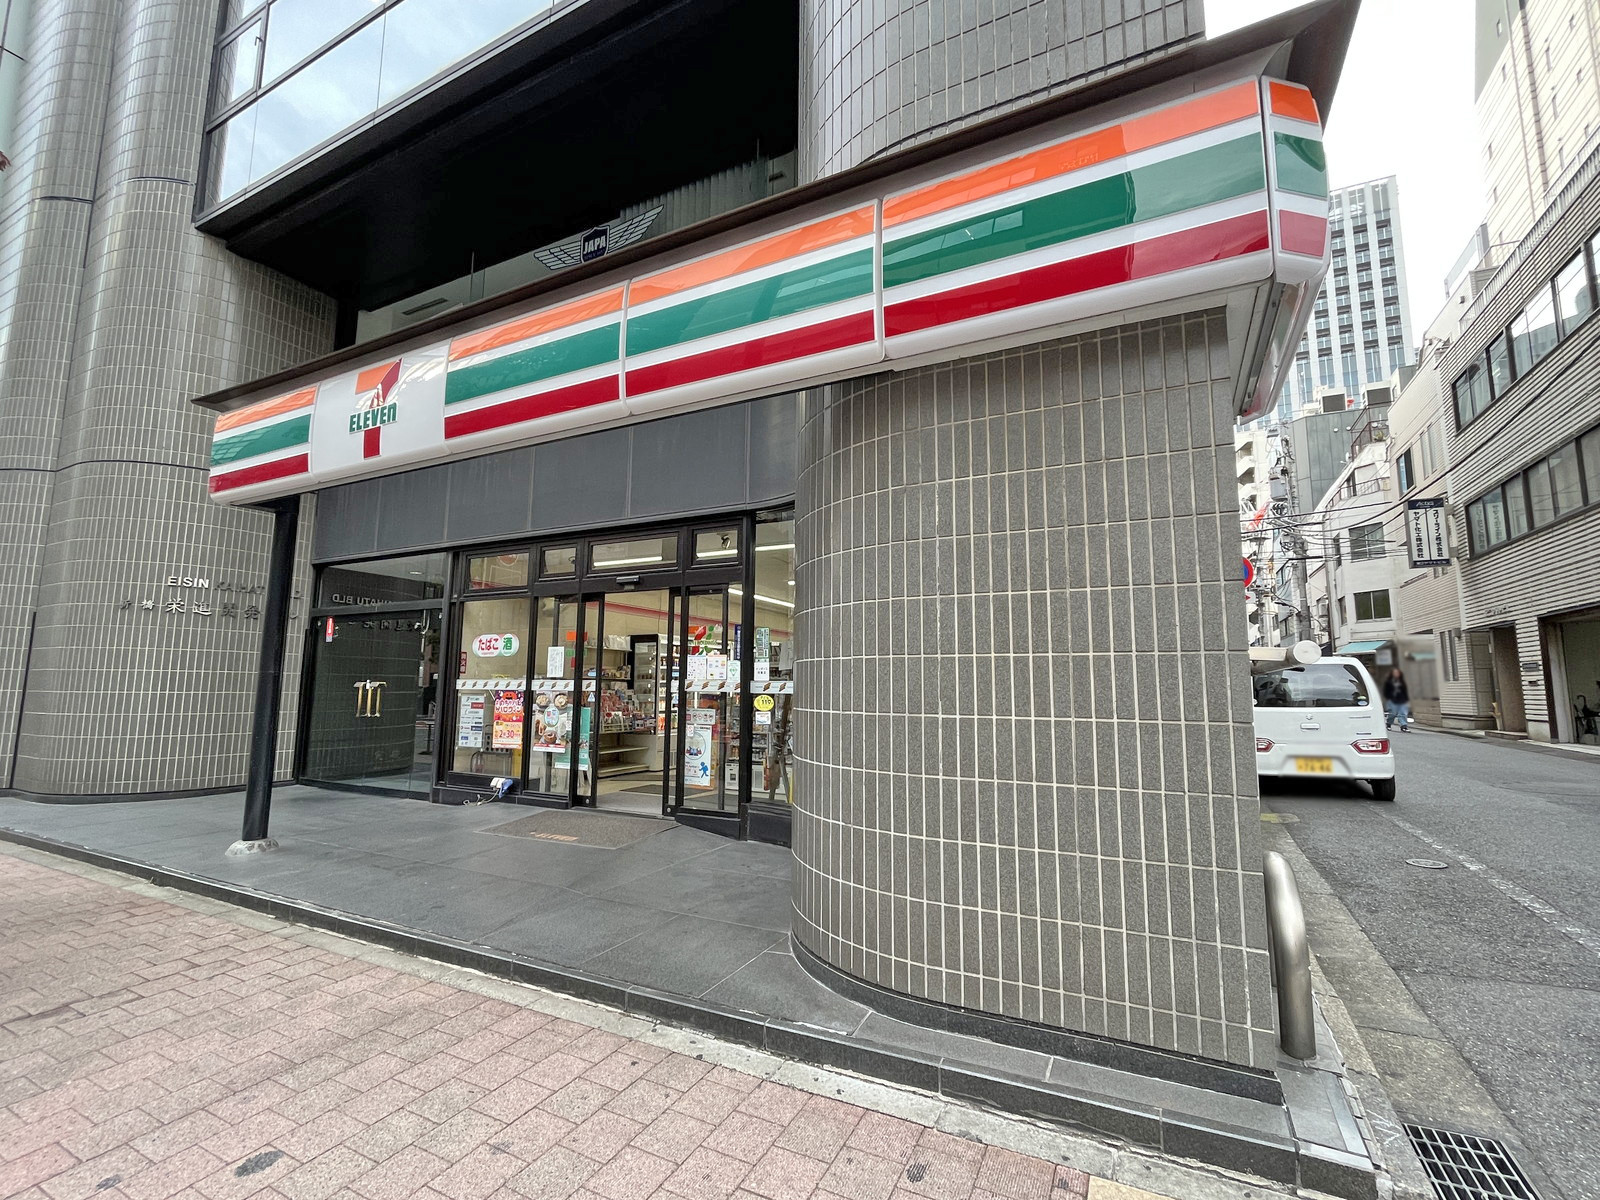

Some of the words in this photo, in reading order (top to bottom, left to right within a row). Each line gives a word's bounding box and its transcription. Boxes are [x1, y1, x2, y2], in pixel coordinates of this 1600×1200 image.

[583, 235, 607, 254] JAPA
[167, 576, 210, 589] EISIN
[478, 637, 499, 651] たばこ
[502, 637, 513, 651] 酒
